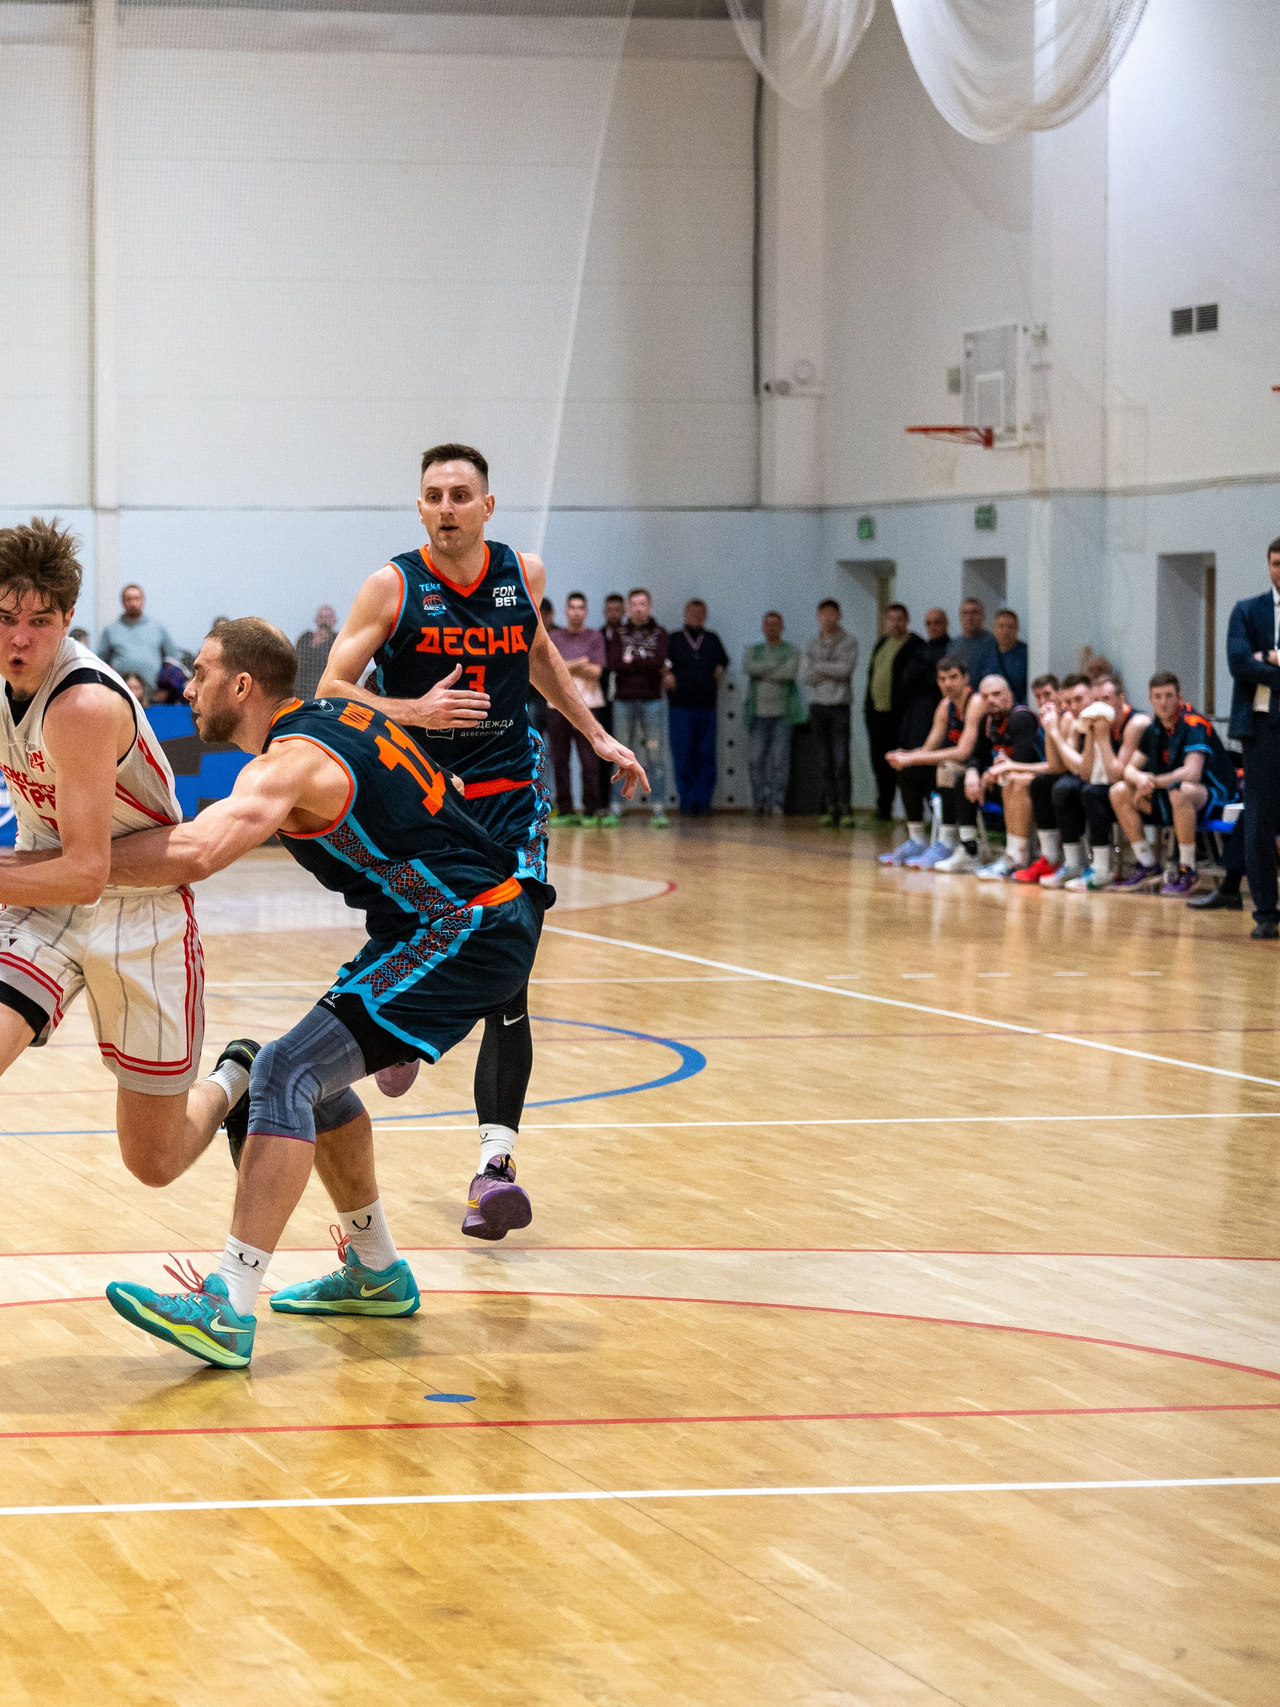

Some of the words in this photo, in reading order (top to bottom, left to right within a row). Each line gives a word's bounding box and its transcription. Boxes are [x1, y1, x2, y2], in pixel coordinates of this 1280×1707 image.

[492, 585, 516, 598] FON
[495, 596, 518, 608] BET
[415, 625, 529, 656] ДЕСНА
[374, 719, 446, 816] 11
